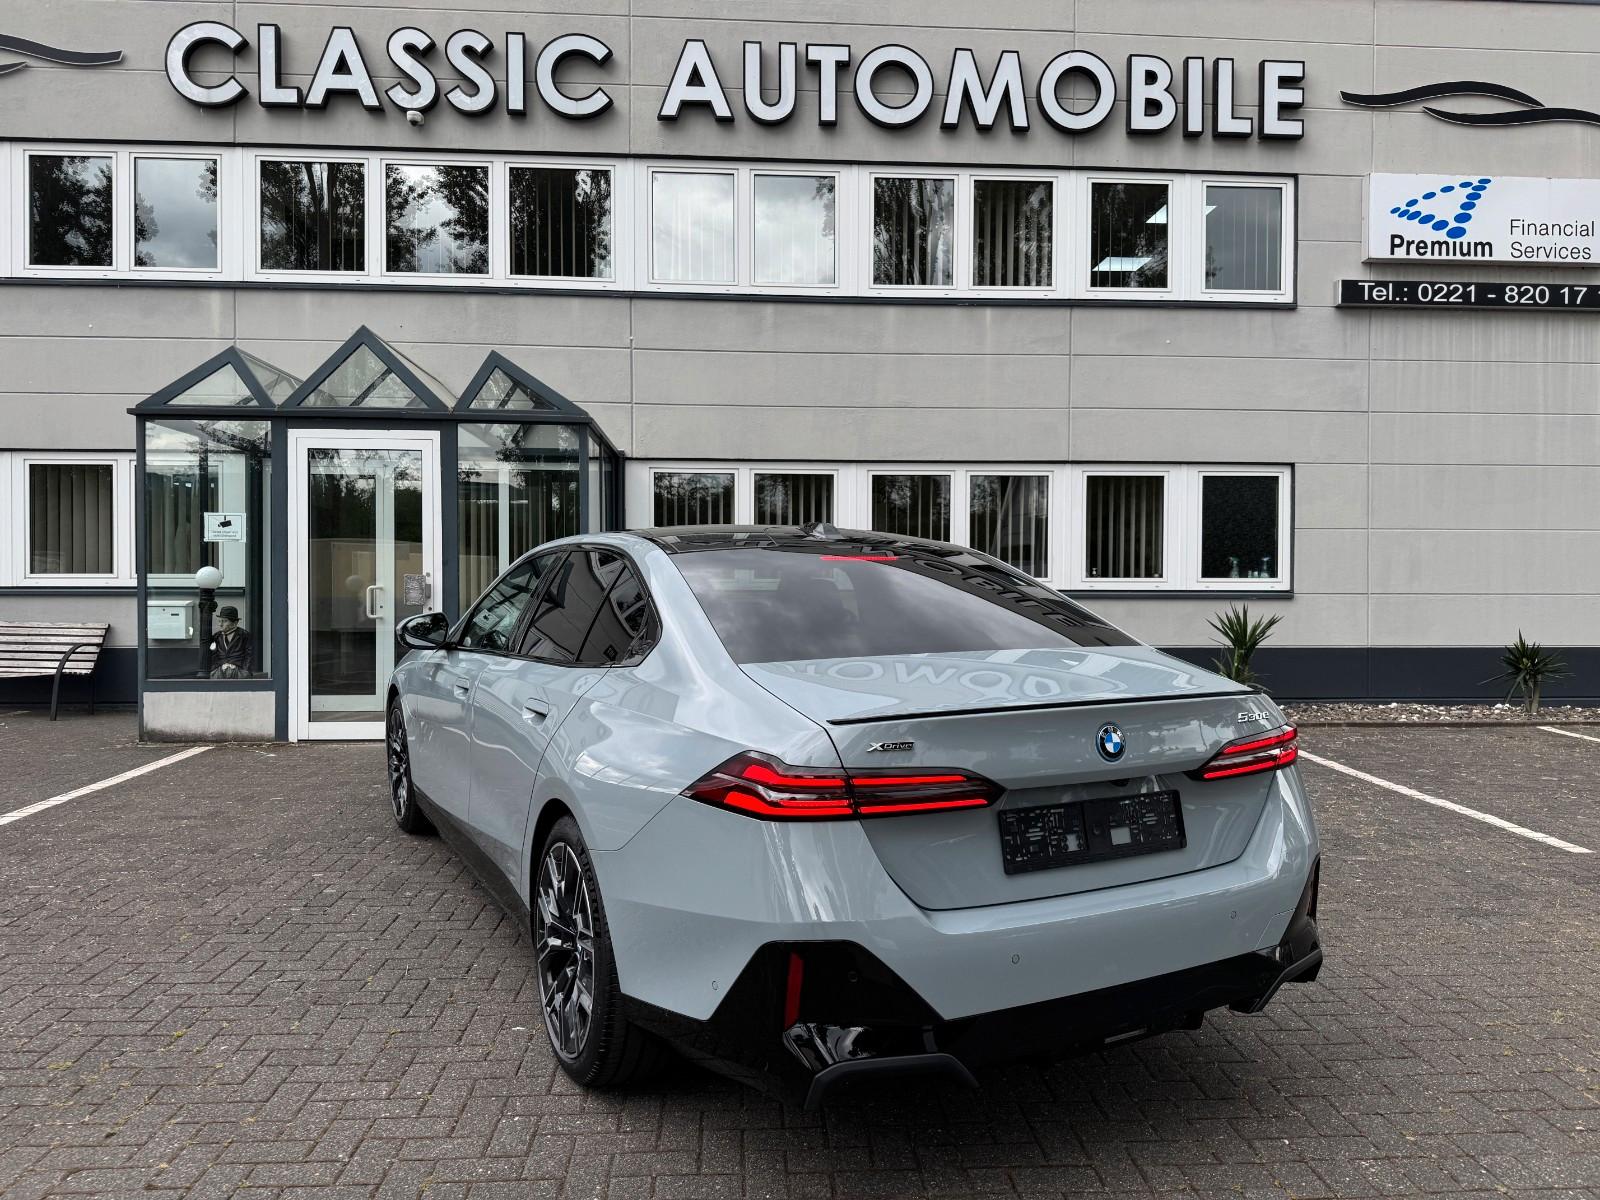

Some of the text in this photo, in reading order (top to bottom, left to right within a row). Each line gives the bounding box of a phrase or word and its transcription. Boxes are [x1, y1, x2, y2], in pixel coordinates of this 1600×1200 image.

[165, 20, 1306, 138] CLASSIC AUTOMOBILE
[1509, 218, 1595, 237] Financial
[1390, 234, 1493, 258] Premium
[1510, 241, 1592, 260] Services
[1358, 282, 1408, 301] Tel.:
[1417, 283, 1476, 303] 0221
[1504, 285, 1550, 304] 820
[1560, 286, 1588, 305] 17
